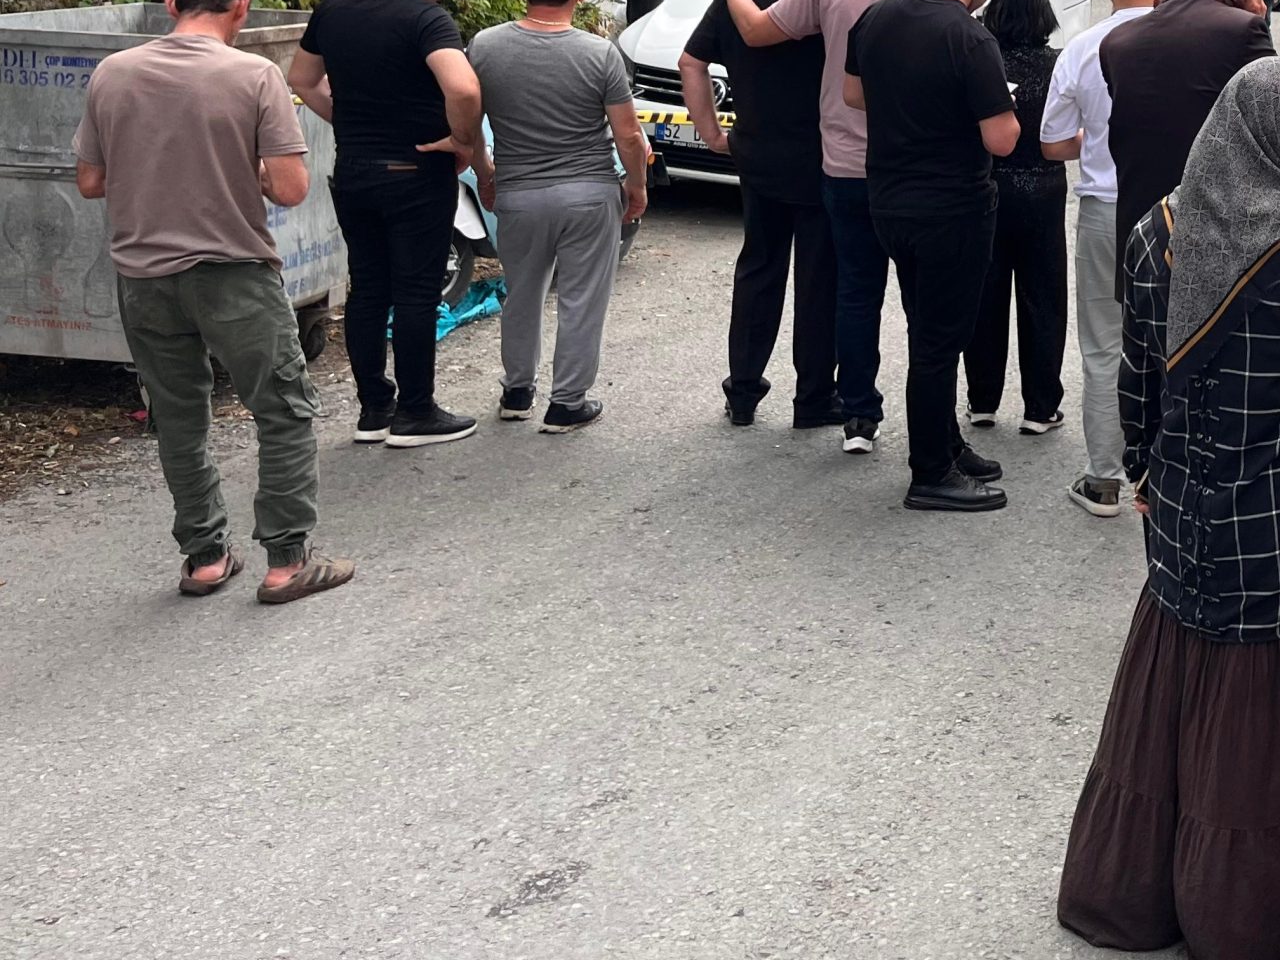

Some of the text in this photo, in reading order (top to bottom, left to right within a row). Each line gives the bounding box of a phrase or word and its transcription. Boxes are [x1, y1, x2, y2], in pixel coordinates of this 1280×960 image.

[19, 70, 48, 87] 305
[54, 72, 75, 88] 02
[665, 124, 681, 139] 52
